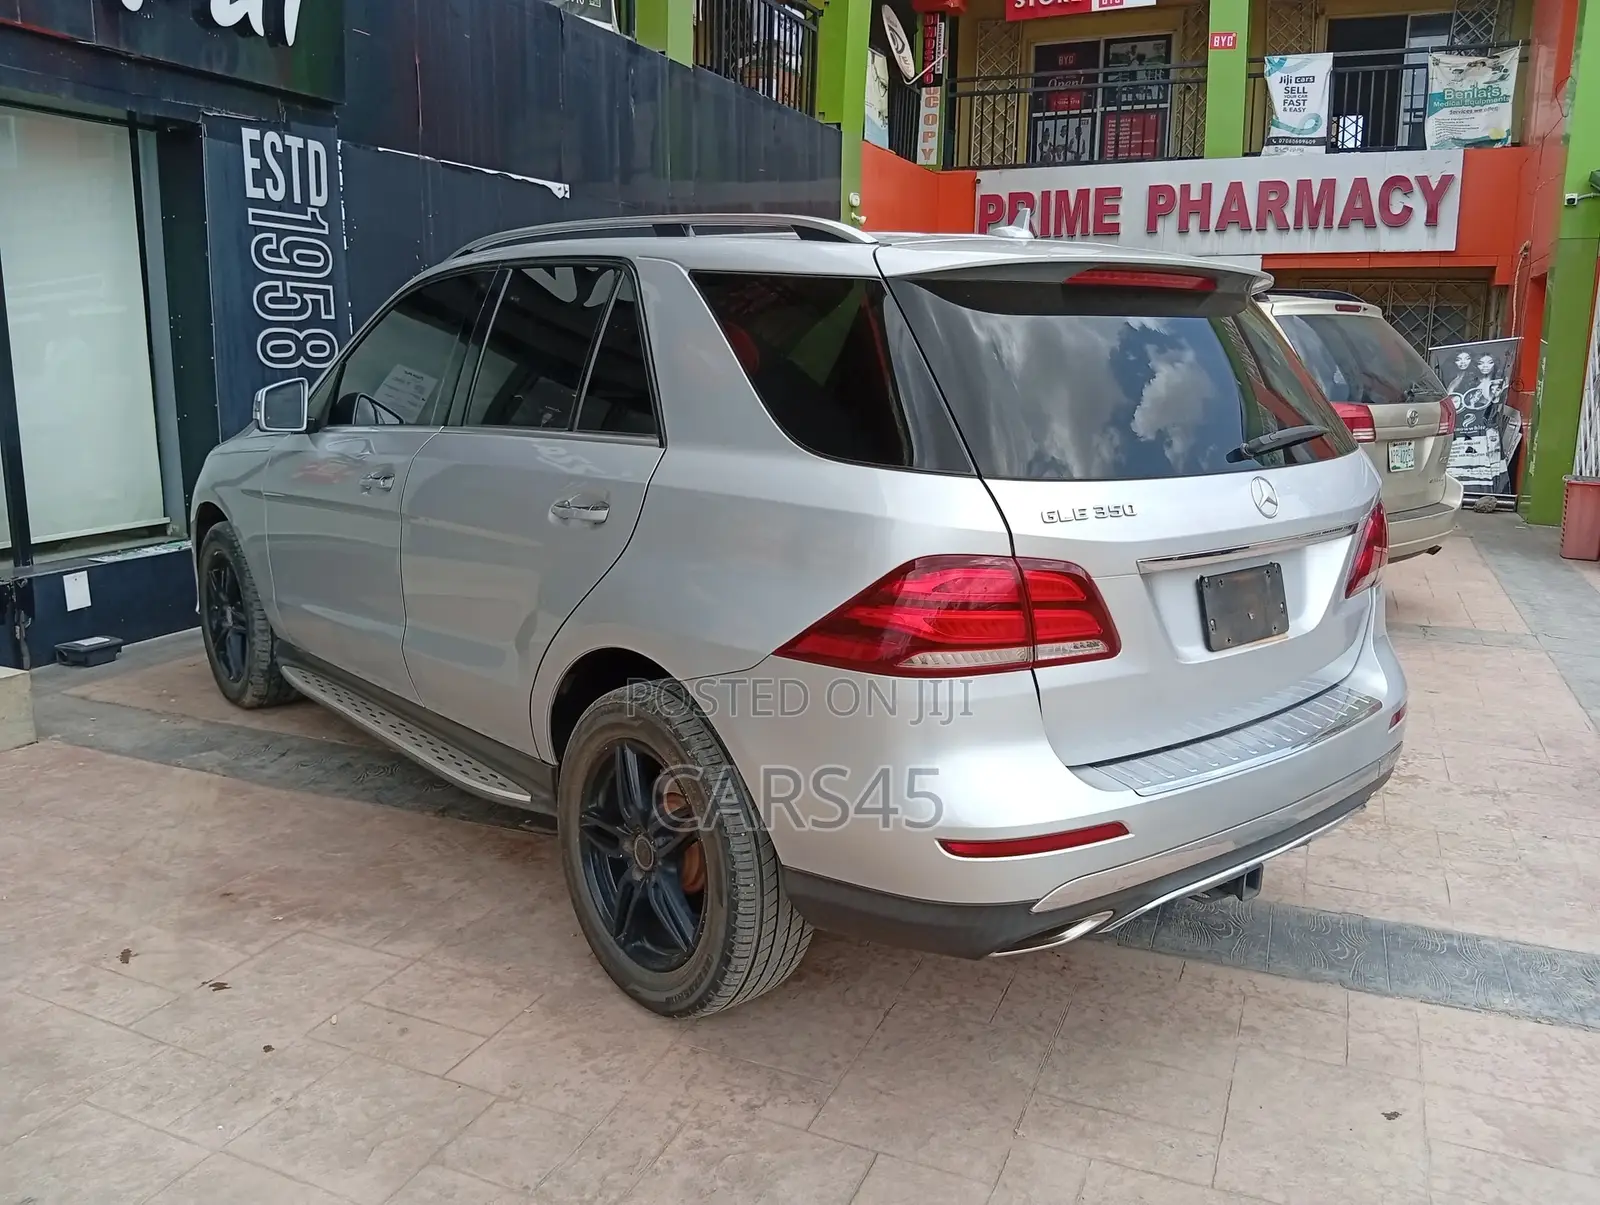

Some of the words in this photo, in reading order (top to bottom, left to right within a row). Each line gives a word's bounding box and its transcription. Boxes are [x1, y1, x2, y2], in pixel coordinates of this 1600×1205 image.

[1283, 99, 1308, 107] FAST
[1284, 86, 1308, 94] SELL
[241, 127, 329, 207] ESTD
[978, 186, 1123, 239] PRIME
[1146, 174, 1456, 234] PHARMACY
[248, 207, 339, 369] 1958
[1041, 508, 1089, 524] GLE
[1092, 503, 1138, 520] 350
